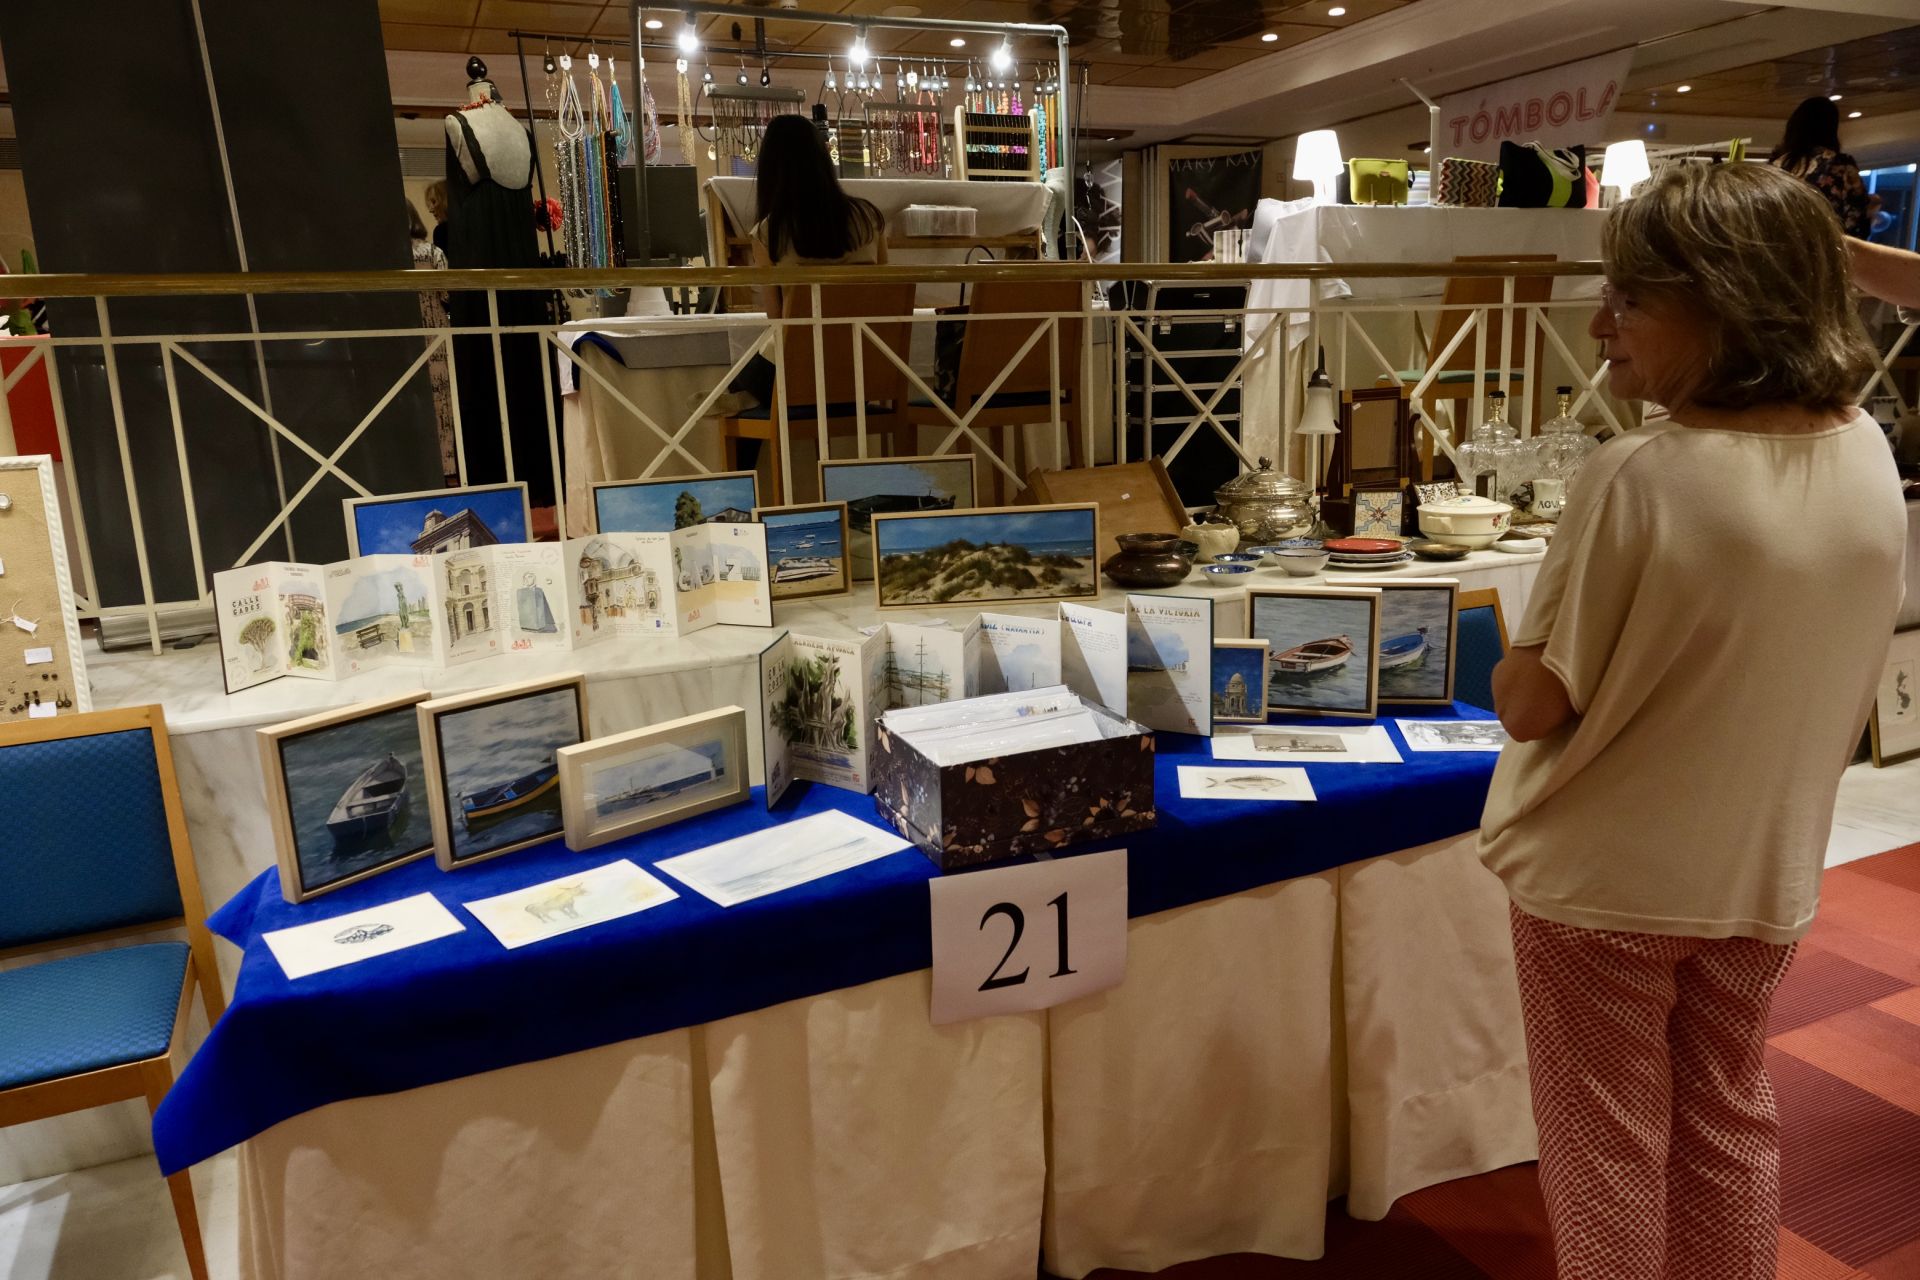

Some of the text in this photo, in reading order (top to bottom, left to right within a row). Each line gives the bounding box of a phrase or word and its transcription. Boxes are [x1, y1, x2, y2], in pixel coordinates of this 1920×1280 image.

[1169, 151, 1260, 172] MARY KAY
[232, 595, 260, 608] CALLE
[232, 602, 261, 616] GADES
[1143, 607, 1156, 615] LA
[1158, 608, 1200, 618] VICTORIA
[977, 890, 1079, 993] 21
